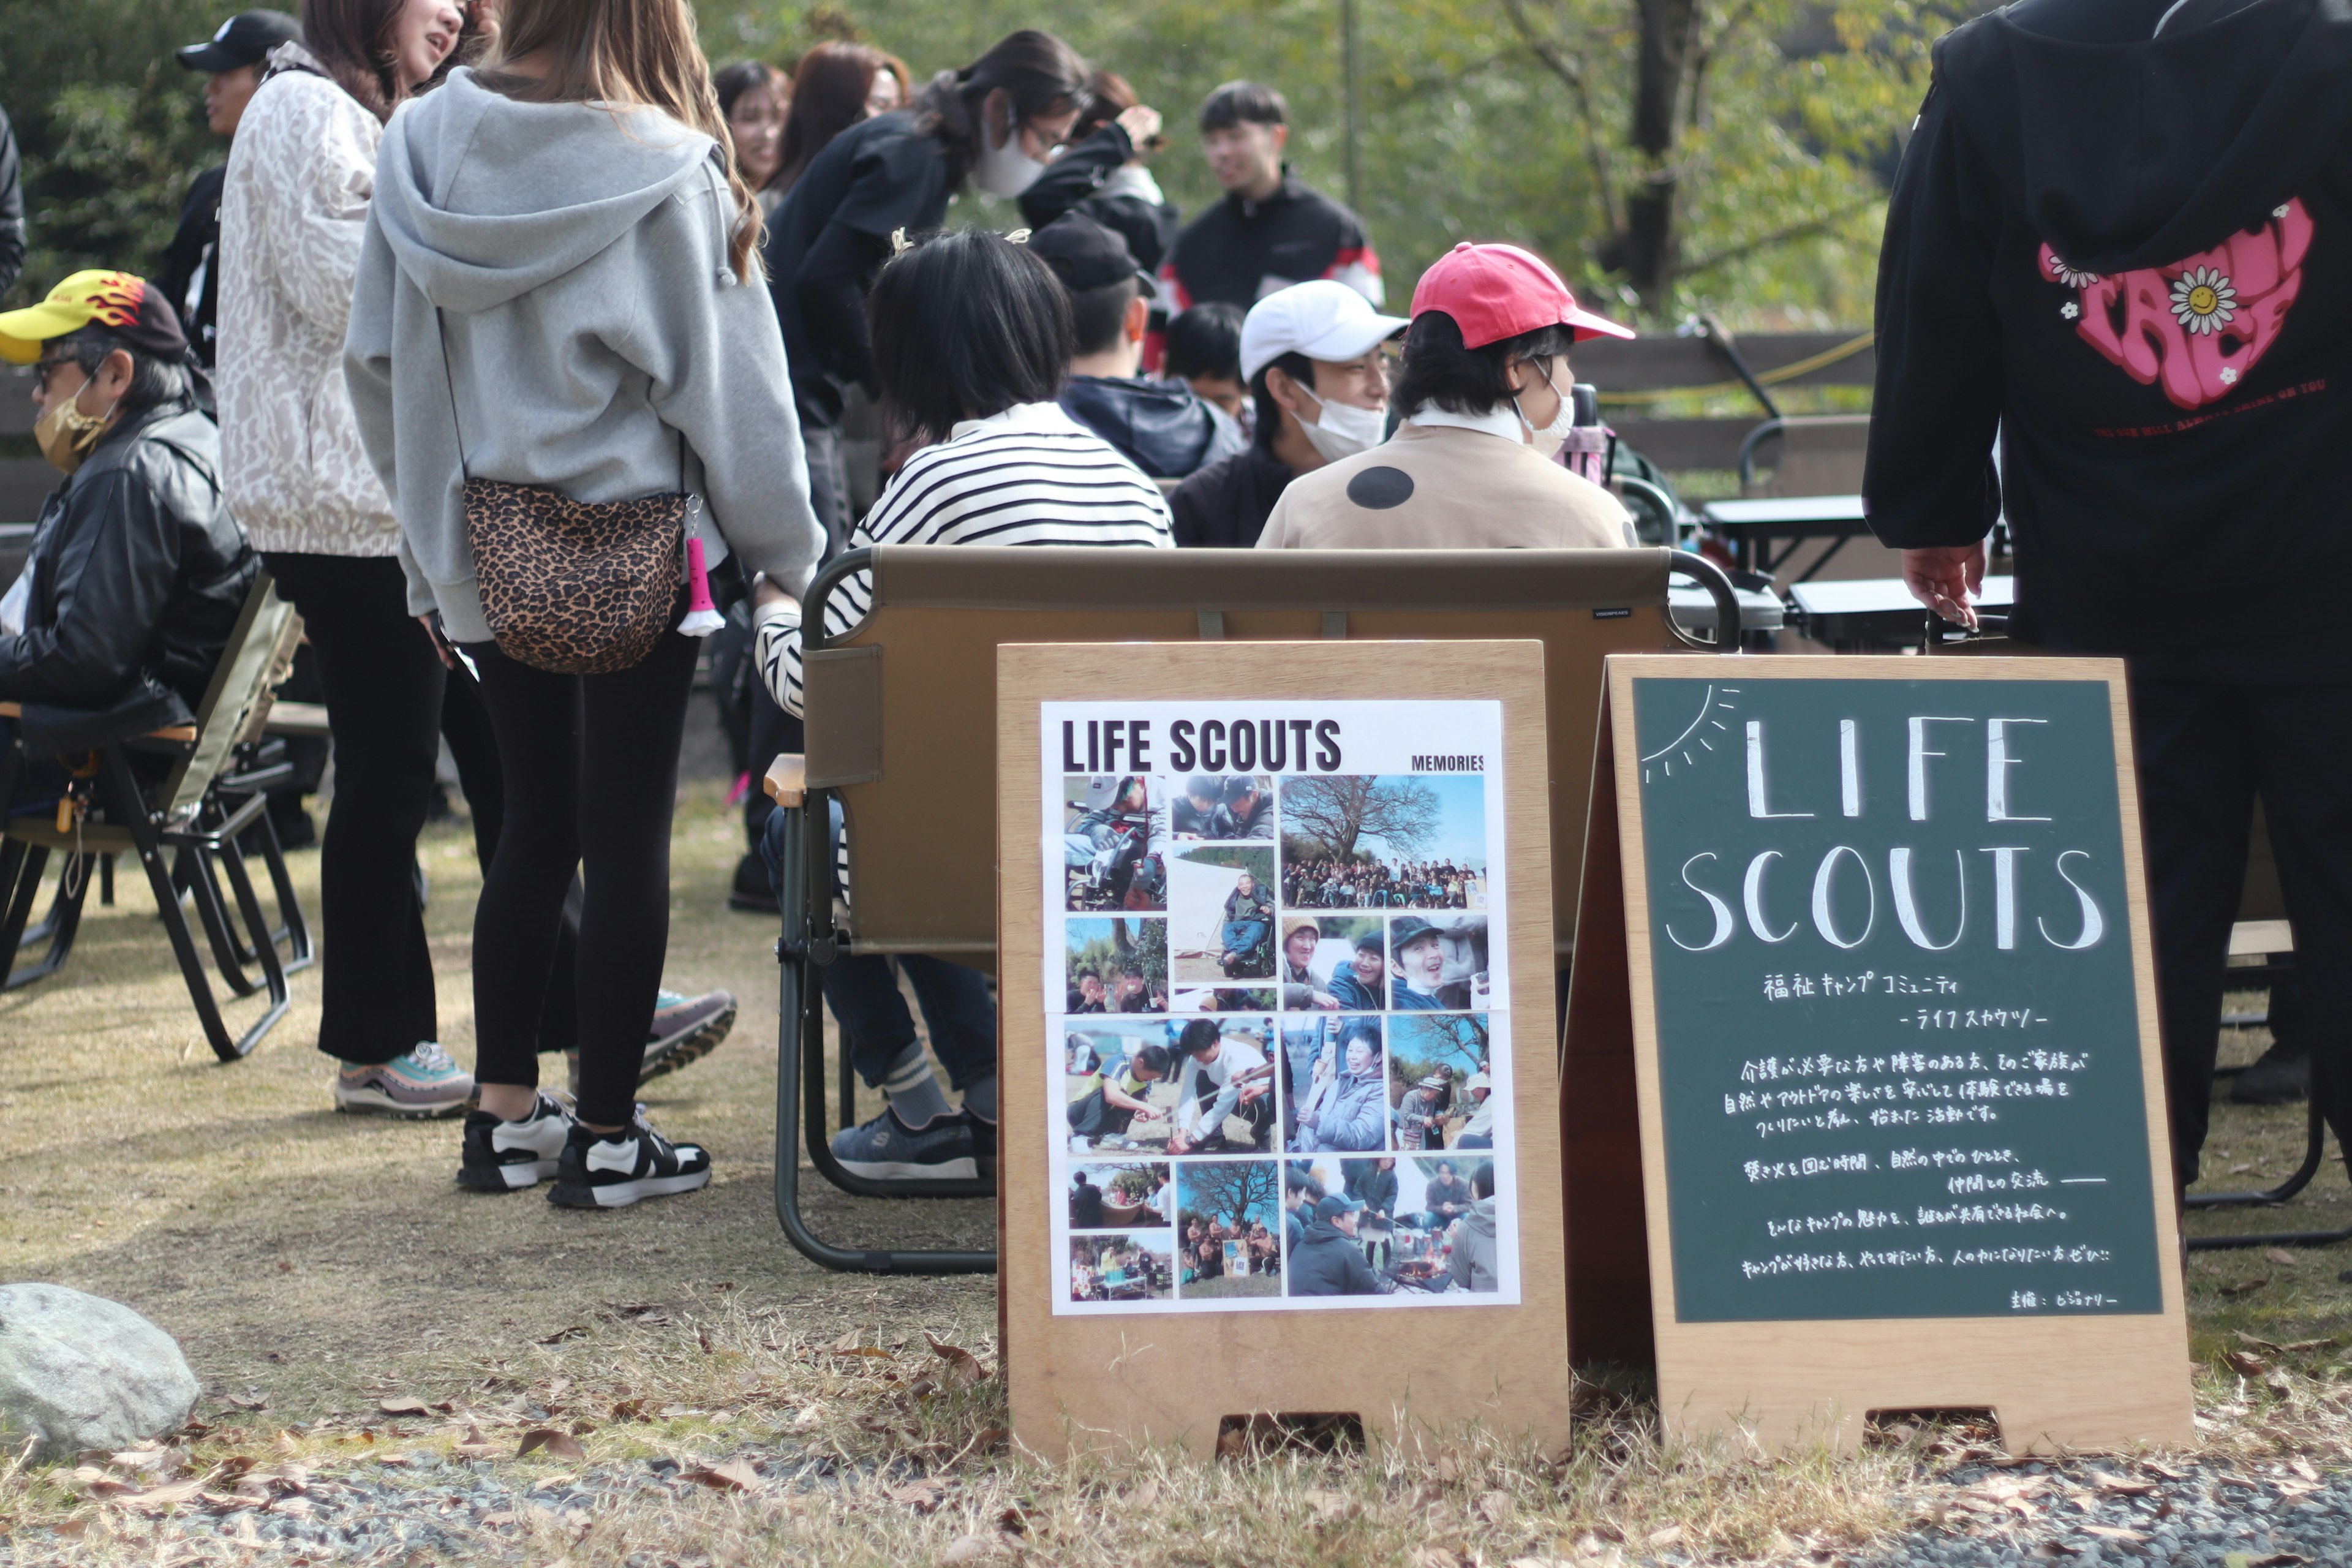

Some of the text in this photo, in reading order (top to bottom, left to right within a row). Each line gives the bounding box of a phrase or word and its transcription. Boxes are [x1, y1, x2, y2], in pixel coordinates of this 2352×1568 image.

[2278, 386, 2297, 399] ON
[2300, 379, 2326, 394] YOU
[1063, 719, 1341, 772] LIFE SCOUTS
[1411, 755, 1484, 771] MEMORIES
[1746, 717, 2052, 822] LIFE
[1666, 846, 2103, 951] SCOUTS
